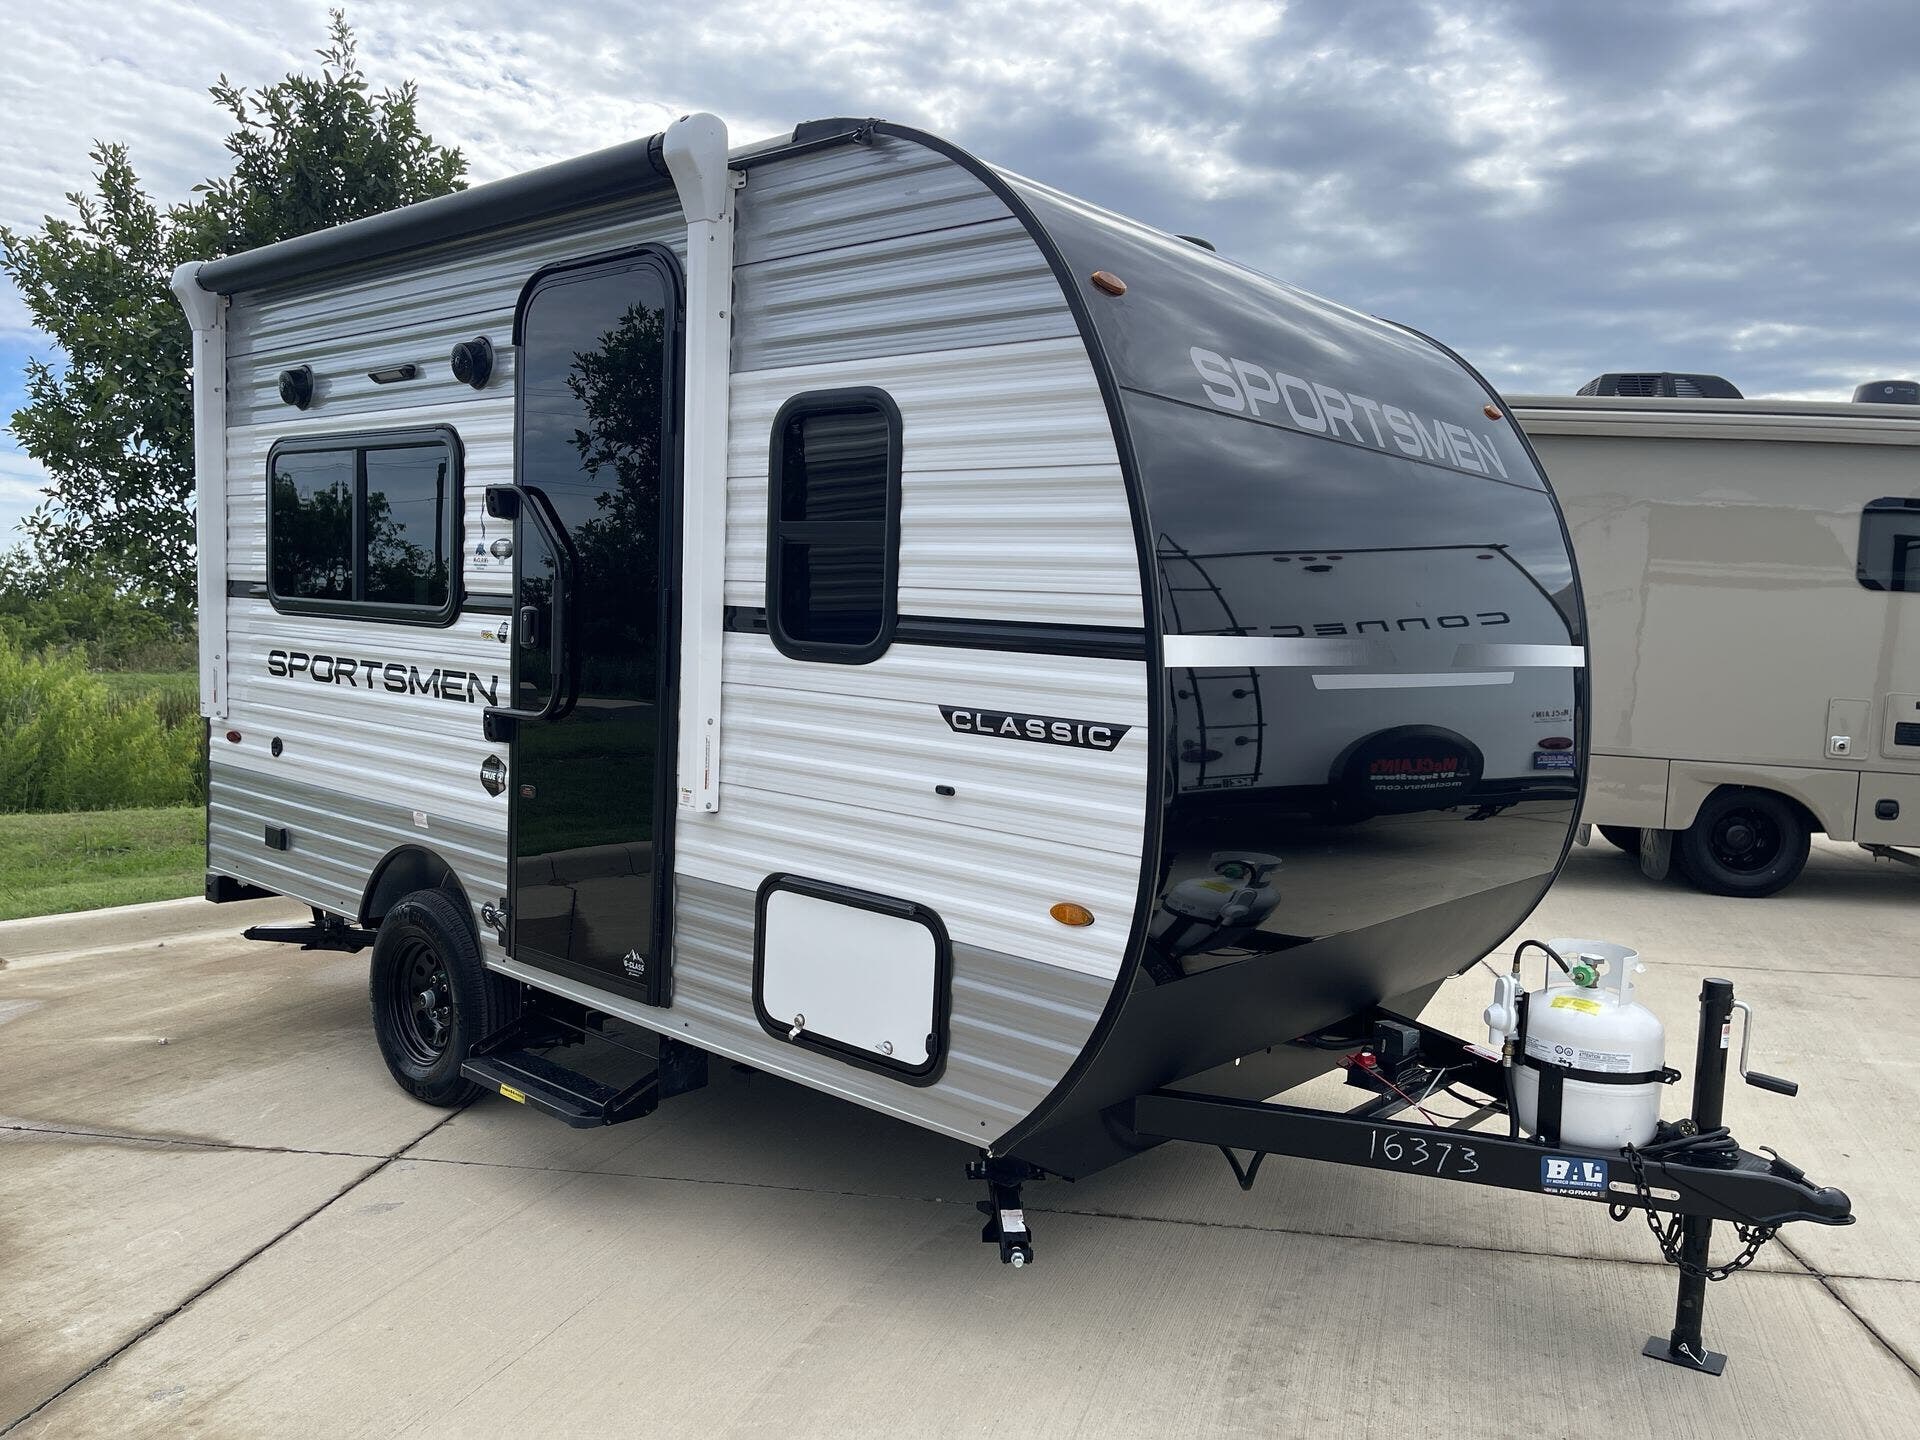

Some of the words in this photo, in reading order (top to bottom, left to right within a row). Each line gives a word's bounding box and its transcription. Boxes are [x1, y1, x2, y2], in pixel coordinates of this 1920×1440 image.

[1190, 346, 1509, 479] SPORTSMEN
[267, 649, 499, 707] SPORTSMEN
[951, 710, 1112, 747] CLASSIC
[1369, 1129, 1480, 1174] 16373
[1546, 1159, 1602, 1182] BAL
